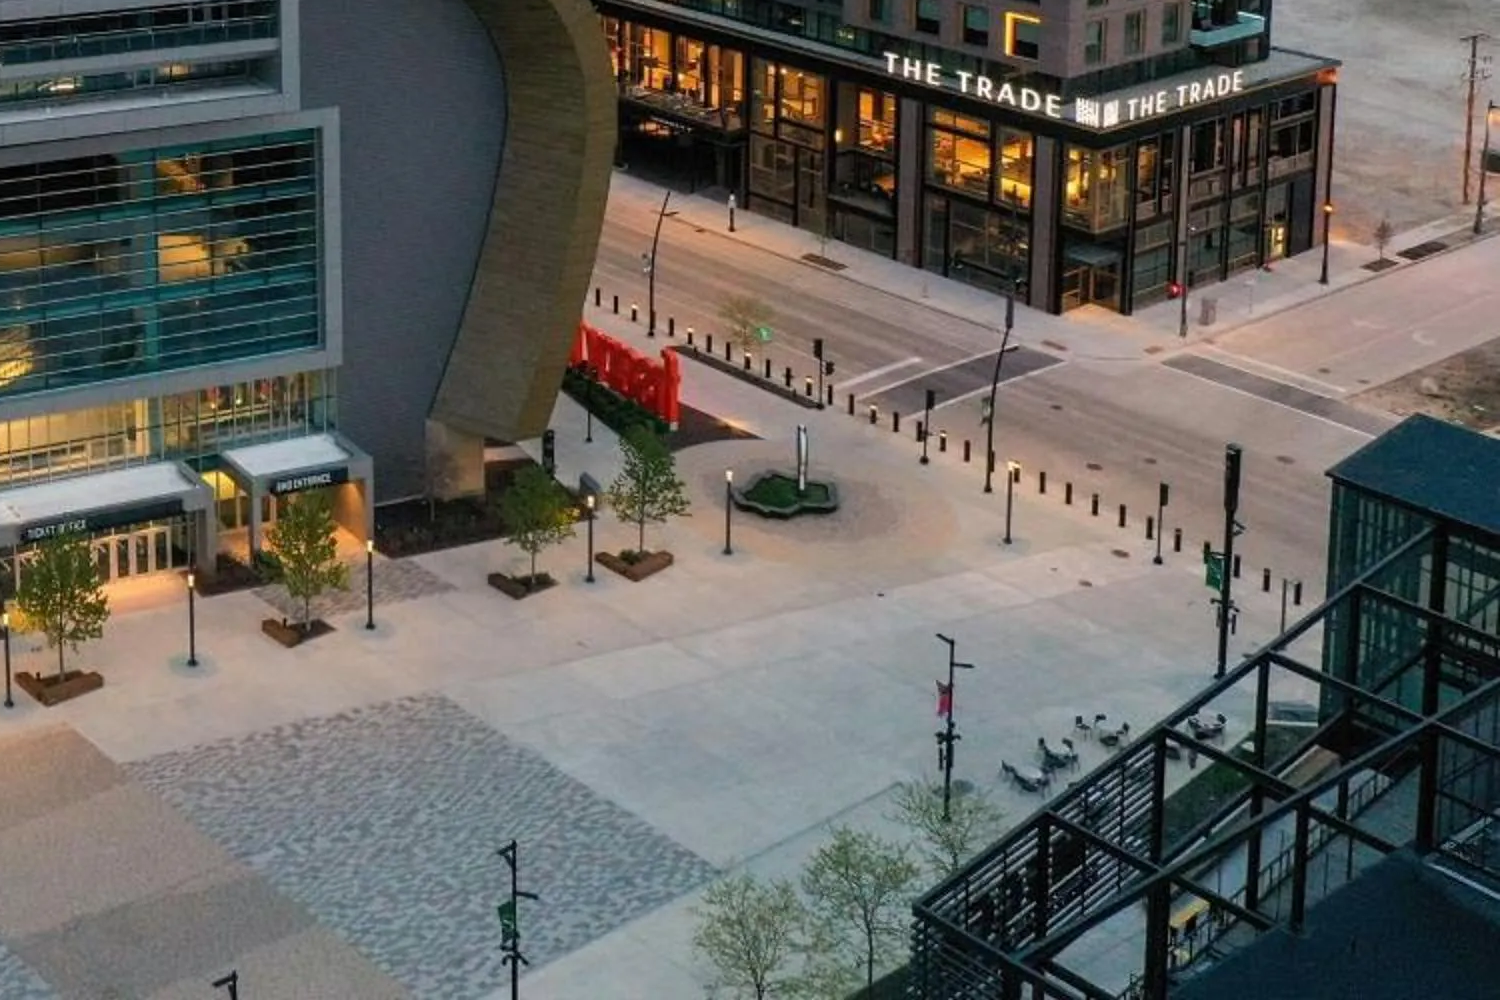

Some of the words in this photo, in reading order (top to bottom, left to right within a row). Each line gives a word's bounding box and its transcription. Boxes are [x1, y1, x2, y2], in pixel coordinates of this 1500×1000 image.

[883, 51, 942, 87] THE
[955, 70, 1062, 119] TRADE
[1127, 90, 1167, 121] THE
[1176, 69, 1245, 107] TRADE
